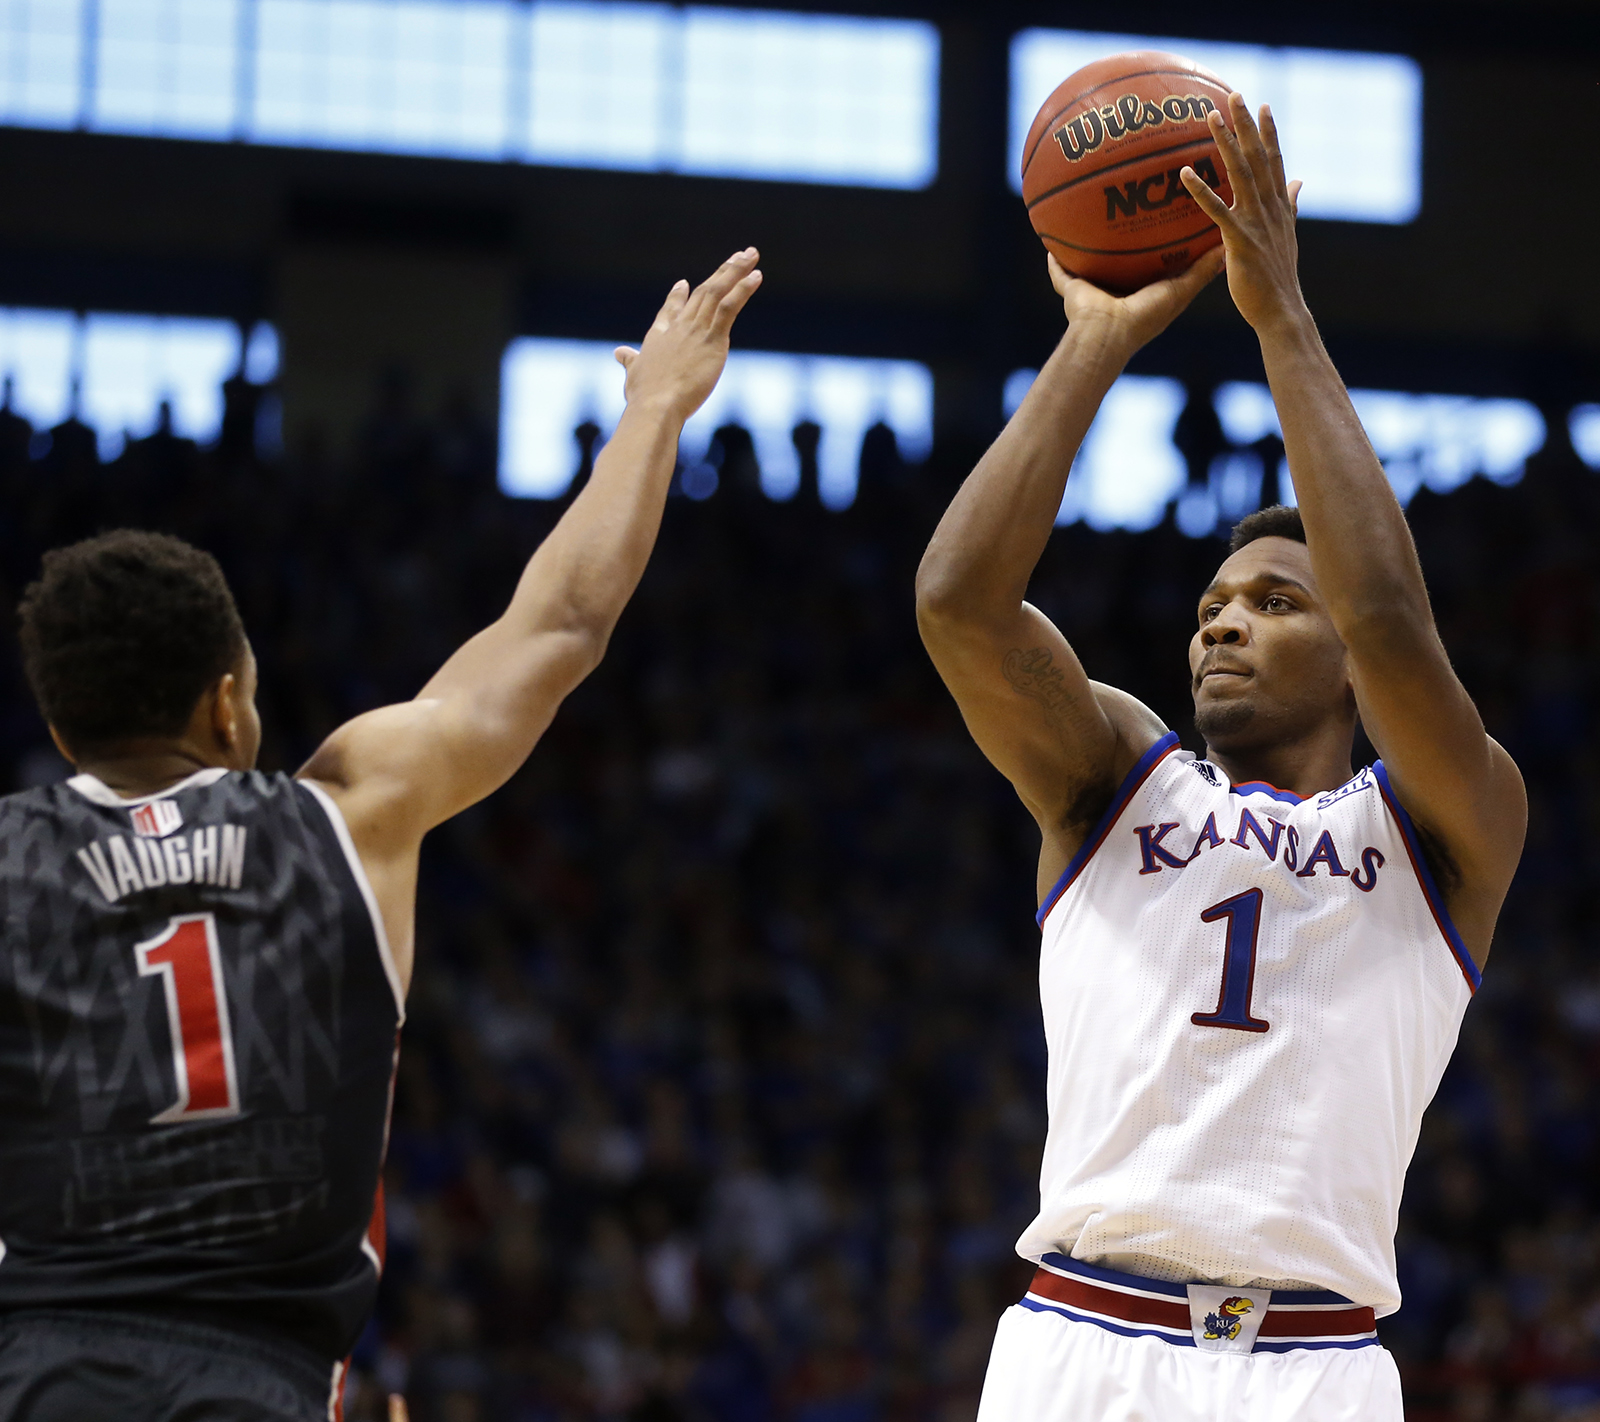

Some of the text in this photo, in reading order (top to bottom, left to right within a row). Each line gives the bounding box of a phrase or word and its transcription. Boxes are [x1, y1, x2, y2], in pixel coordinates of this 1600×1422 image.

[1053, 94, 1216, 163] Wilson
[77, 824, 247, 902] VAUGHN
[1133, 807, 1385, 893] KANSAS
[1190, 887, 1270, 1033] 1
[133, 911, 241, 1125] 1
[1216, 1319, 1229, 1329] KU
